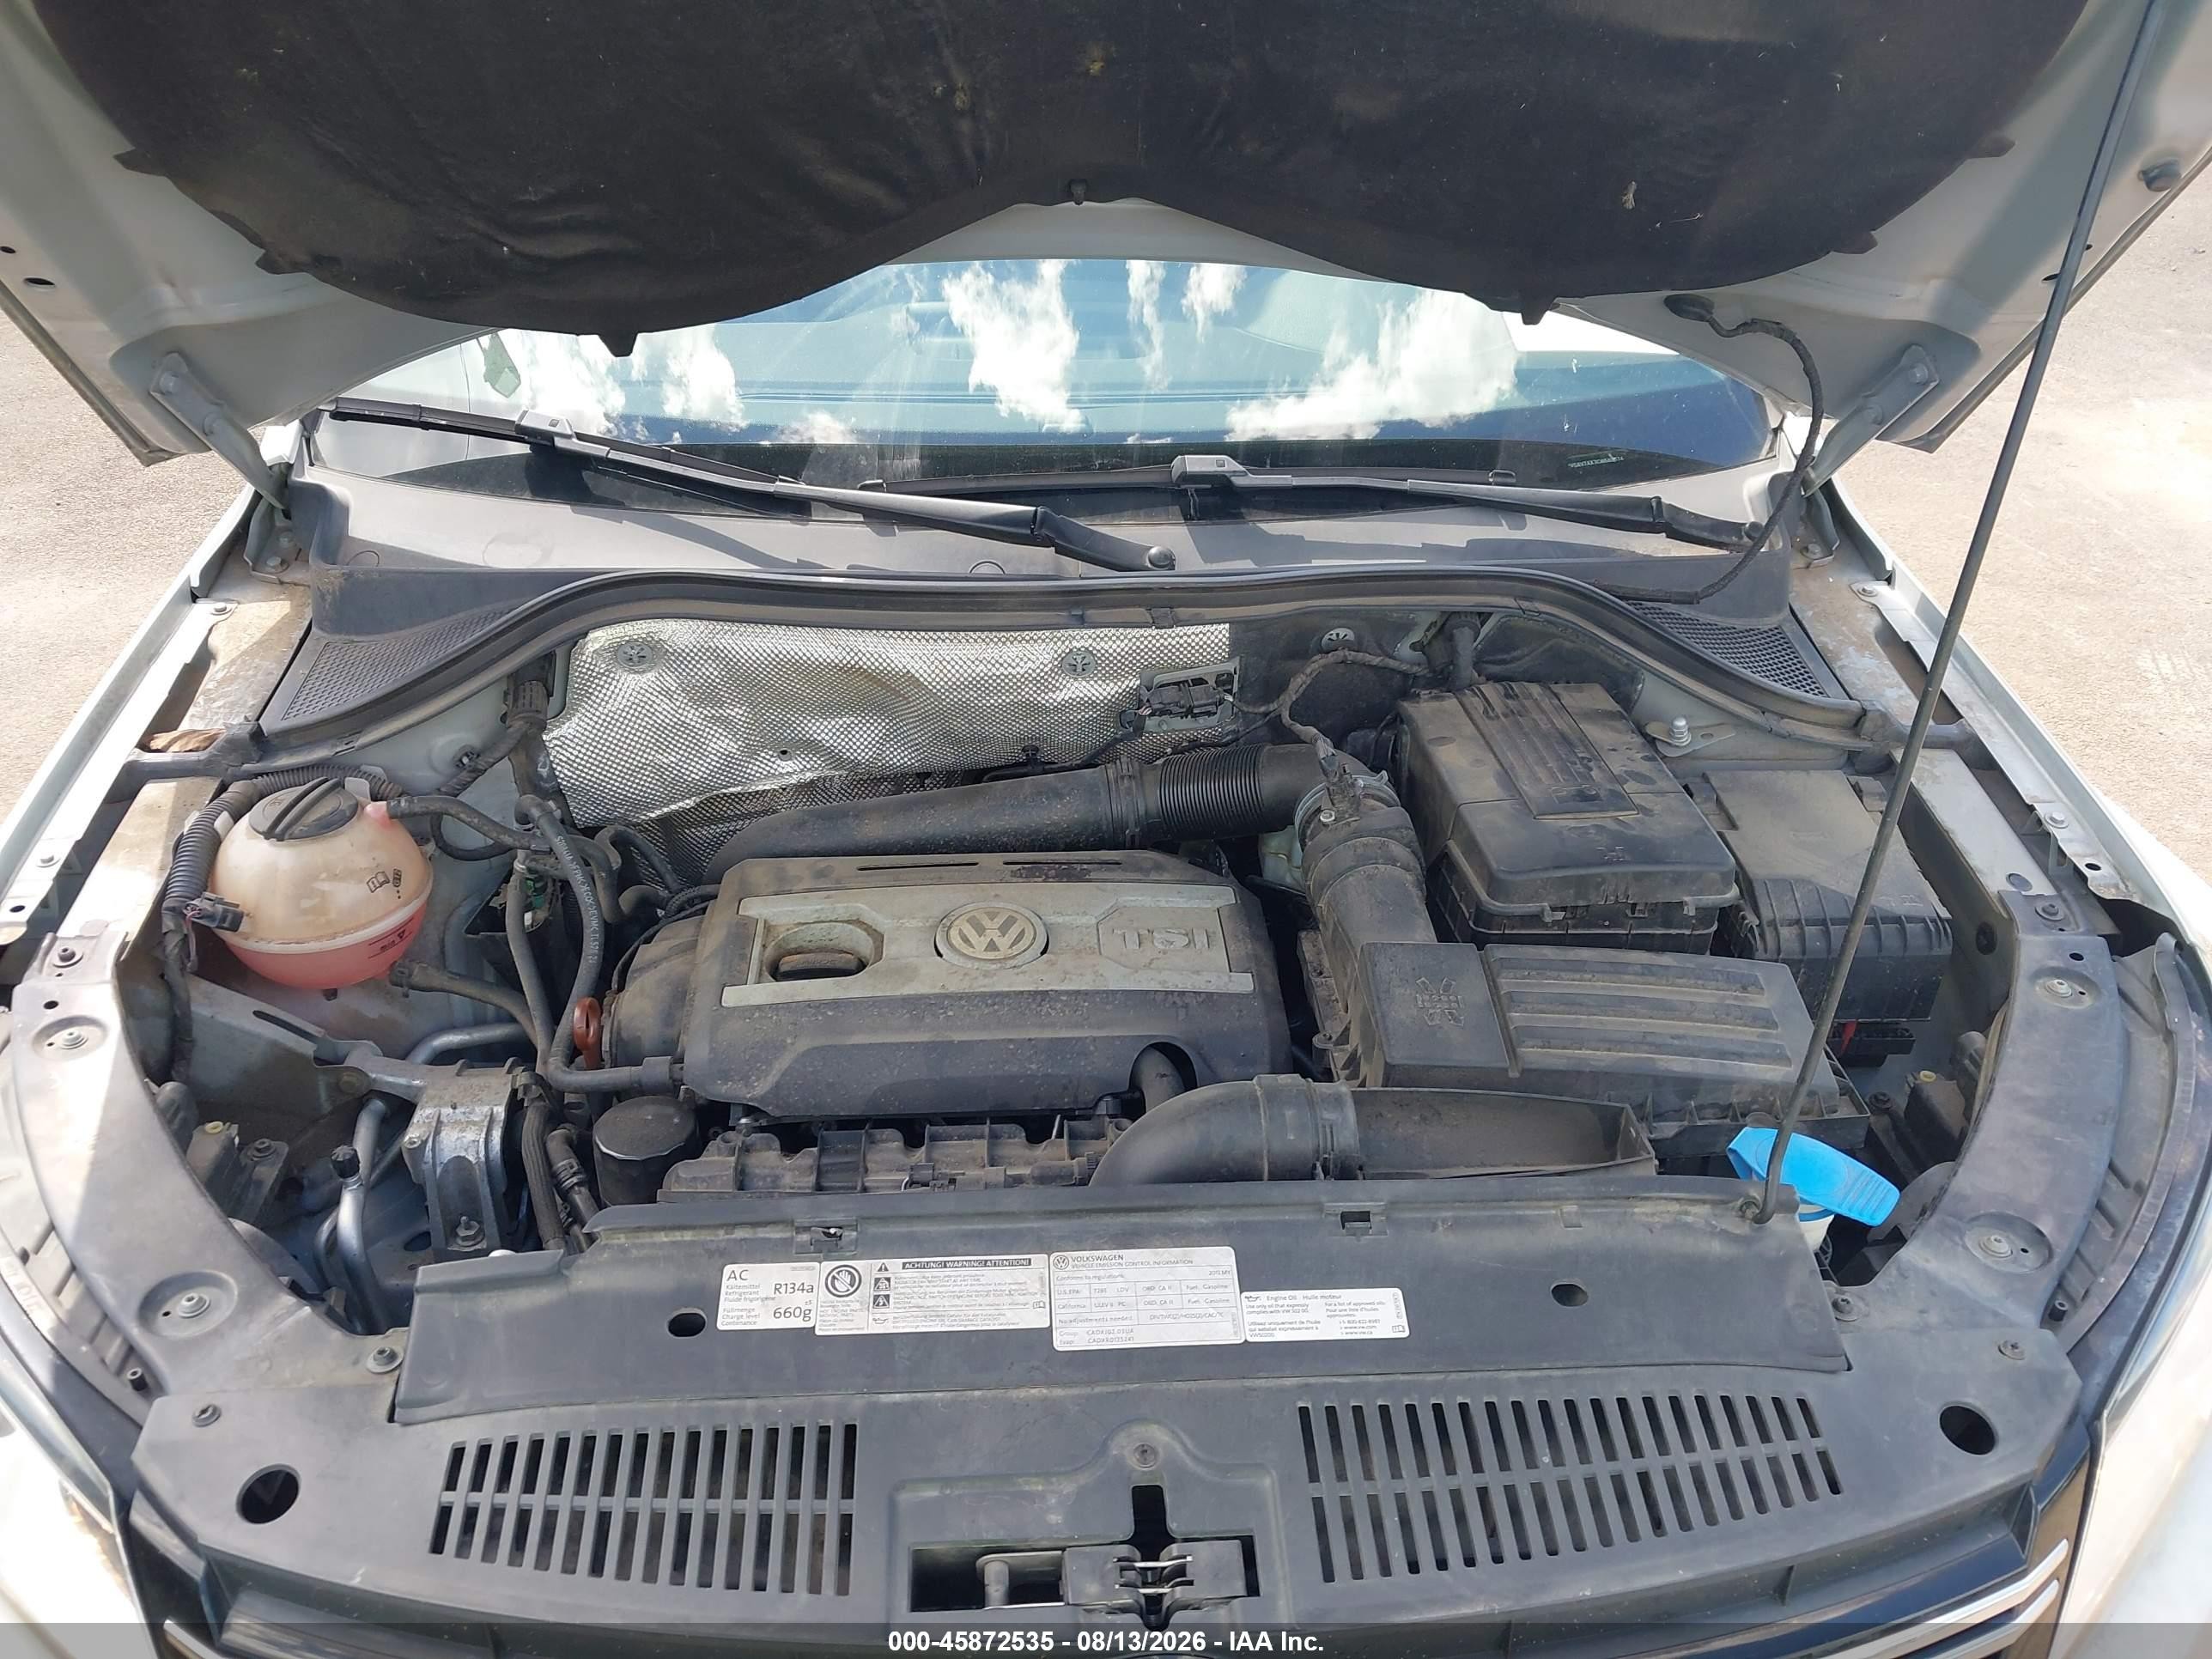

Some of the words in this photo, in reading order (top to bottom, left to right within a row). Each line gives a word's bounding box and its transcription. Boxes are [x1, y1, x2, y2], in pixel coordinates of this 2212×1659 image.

[1112, 927, 1210, 950] TSI
[904, 1261, 945, 1269] ACHTUNG!
[946, 1260, 986, 1268] WARNING!
[987, 1258, 1030, 1267] ATTENTION!
[1071, 1254, 1124, 1263] VOLKSWAGEN
[726, 1269, 749, 1281] AC
[774, 1282, 814, 1295] R134a
[773, 1306, 812, 1322] 660g
